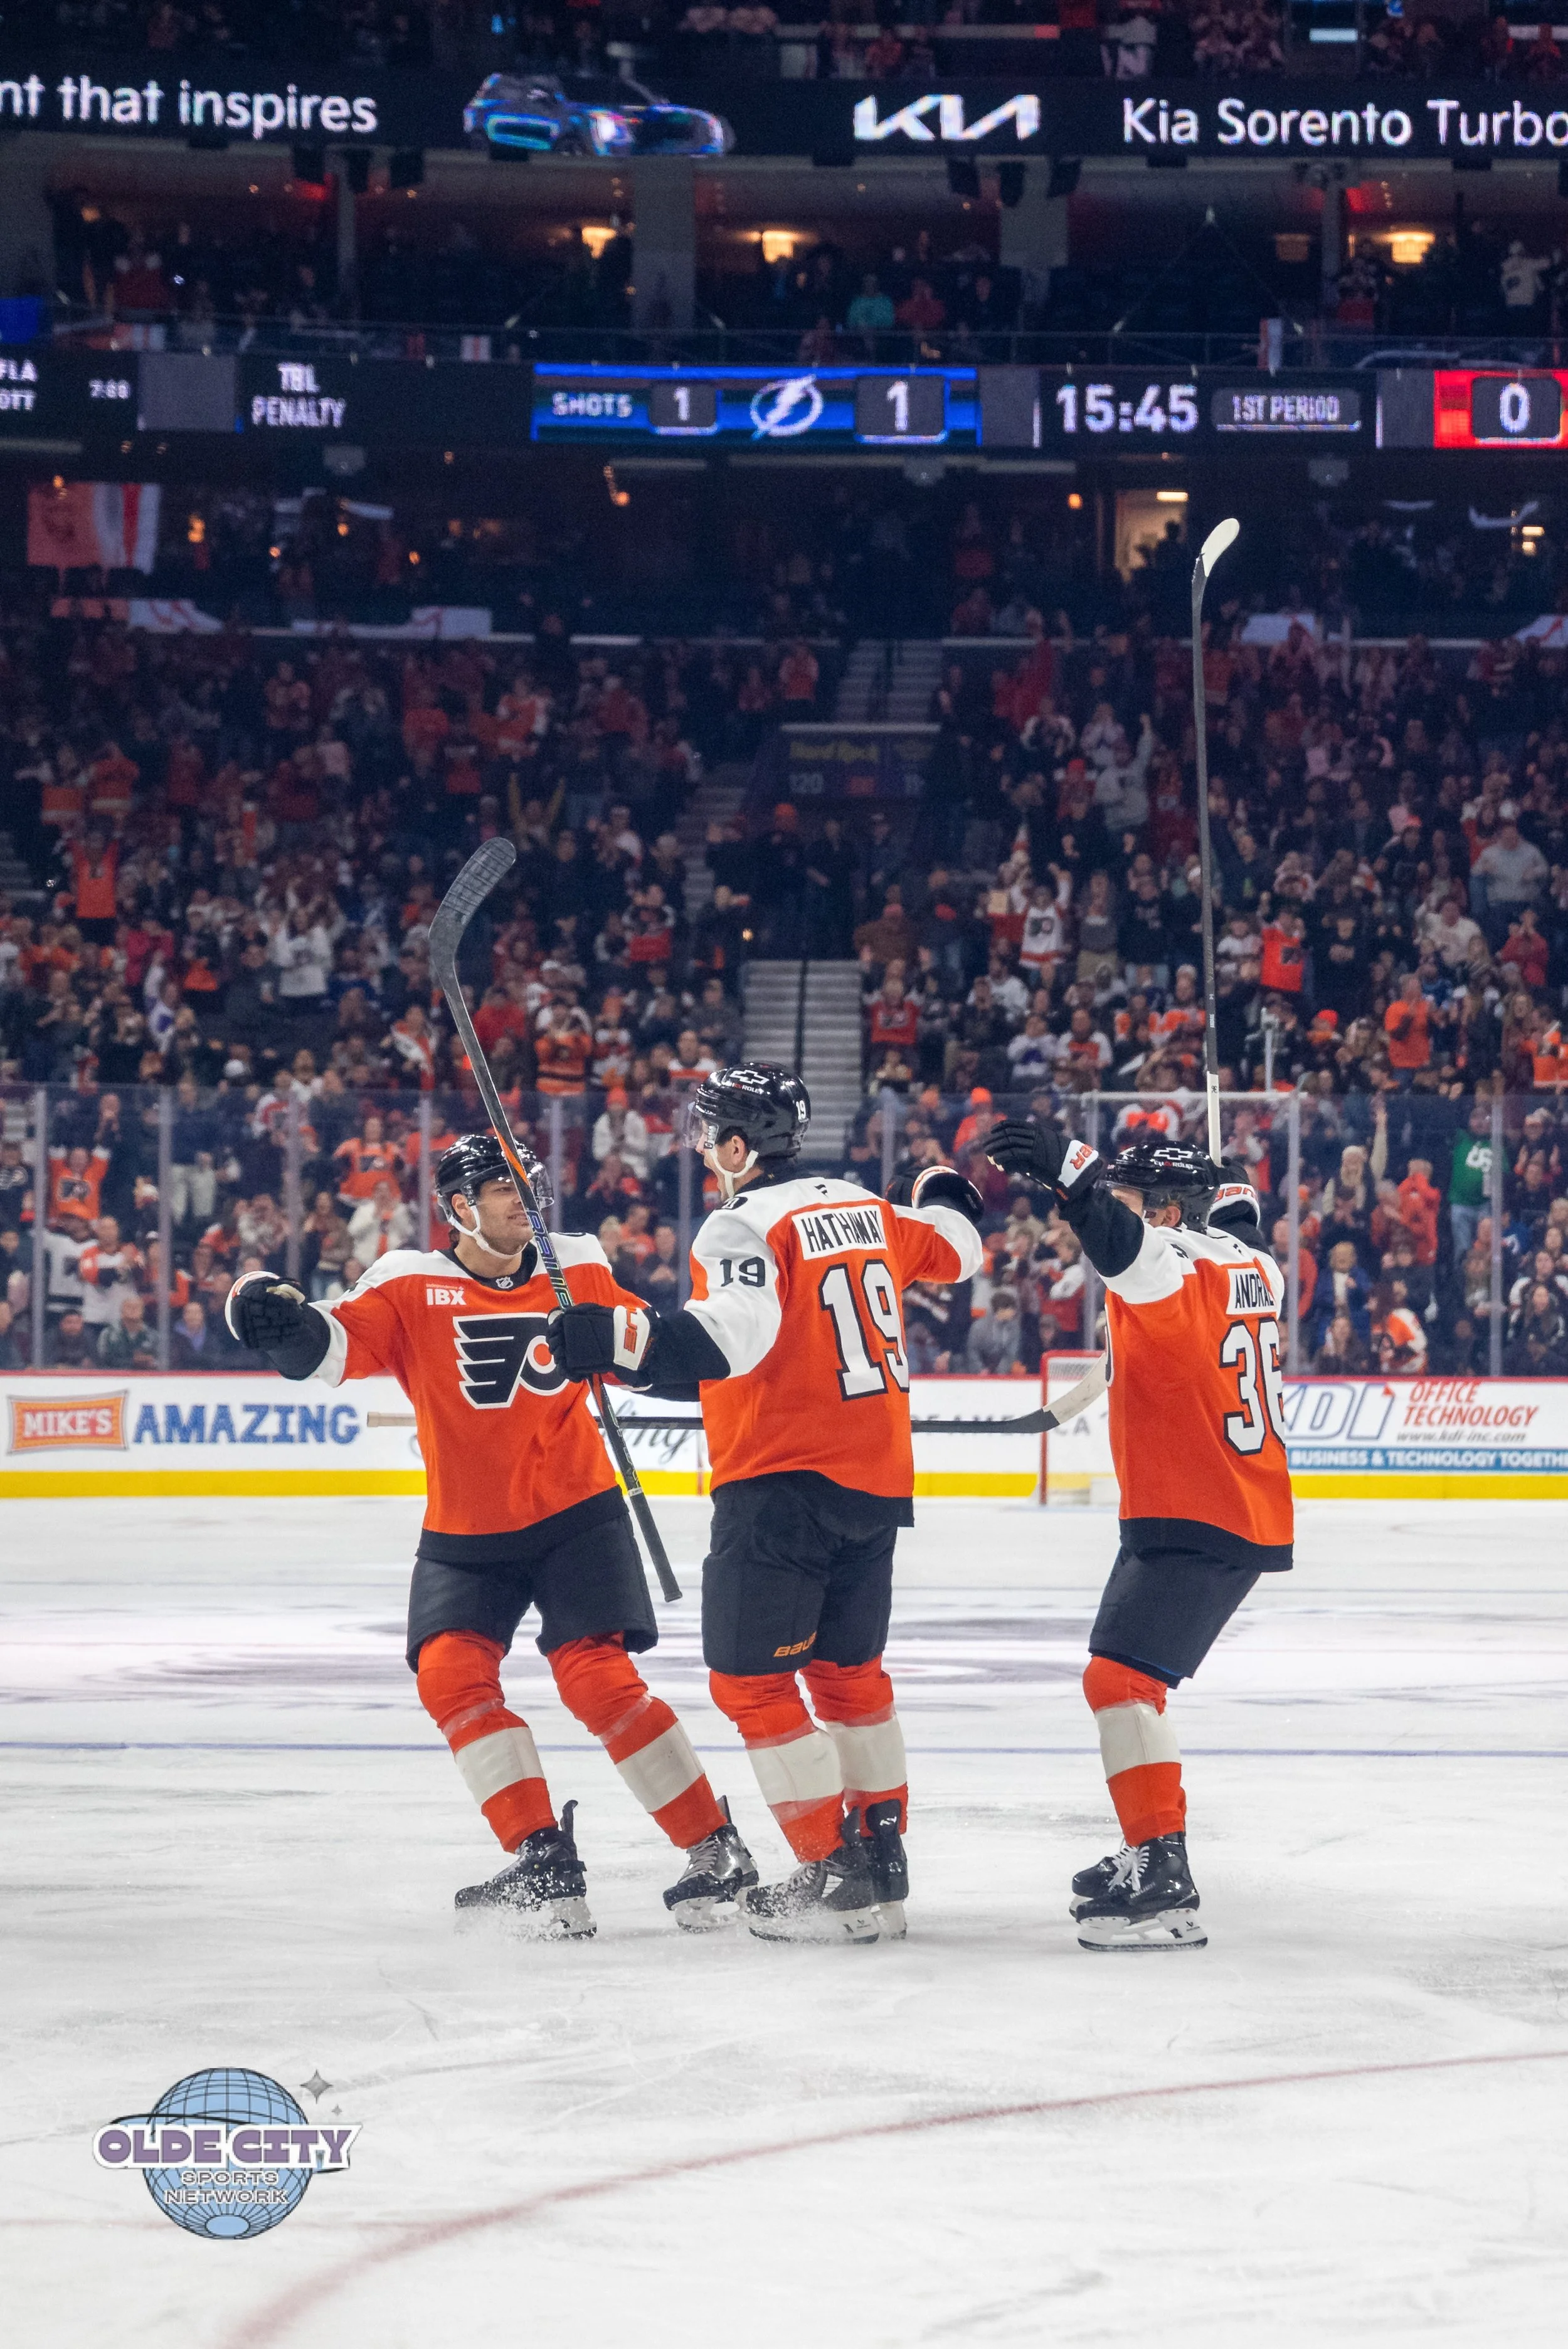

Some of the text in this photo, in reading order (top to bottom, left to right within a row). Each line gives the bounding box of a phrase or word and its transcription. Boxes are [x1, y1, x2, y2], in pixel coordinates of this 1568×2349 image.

[58, 75, 164, 124] that
[179, 79, 377, 139] inspires
[1123, 97, 1568, 147] Kia Sorento Turbo
[252, 396, 346, 427] PENALTY
[551, 392, 632, 418] SHOTS
[673, 386, 690, 421] 1
[886, 381, 909, 432] 1
[1056, 384, 1199, 433] 15:45
[1231, 395, 1340, 422] 1ST PERIOD
[1499, 381, 1530, 433] 0
[795, 1100, 807, 1120] 19
[801, 1211, 885, 1253] HATHAWAY
[719, 1256, 766, 1287] 19
[426, 1288, 467, 1305] IBX
[818, 1258, 909, 1402] 19
[1219, 1317, 1286, 1456] 36
[1409, 1380, 1483, 1403] OFFICE
[23, 1408, 113, 1438] MIKE'S
[133, 1404, 360, 1445] AMAZING
[1404, 1405, 1539, 1426] TECHNOLOGY
[1291, 1450, 1369, 1466] BUSINESS
[1372, 1450, 1384, 1466] &
[1387, 1450, 1495, 1468] TECHNOLOGY
